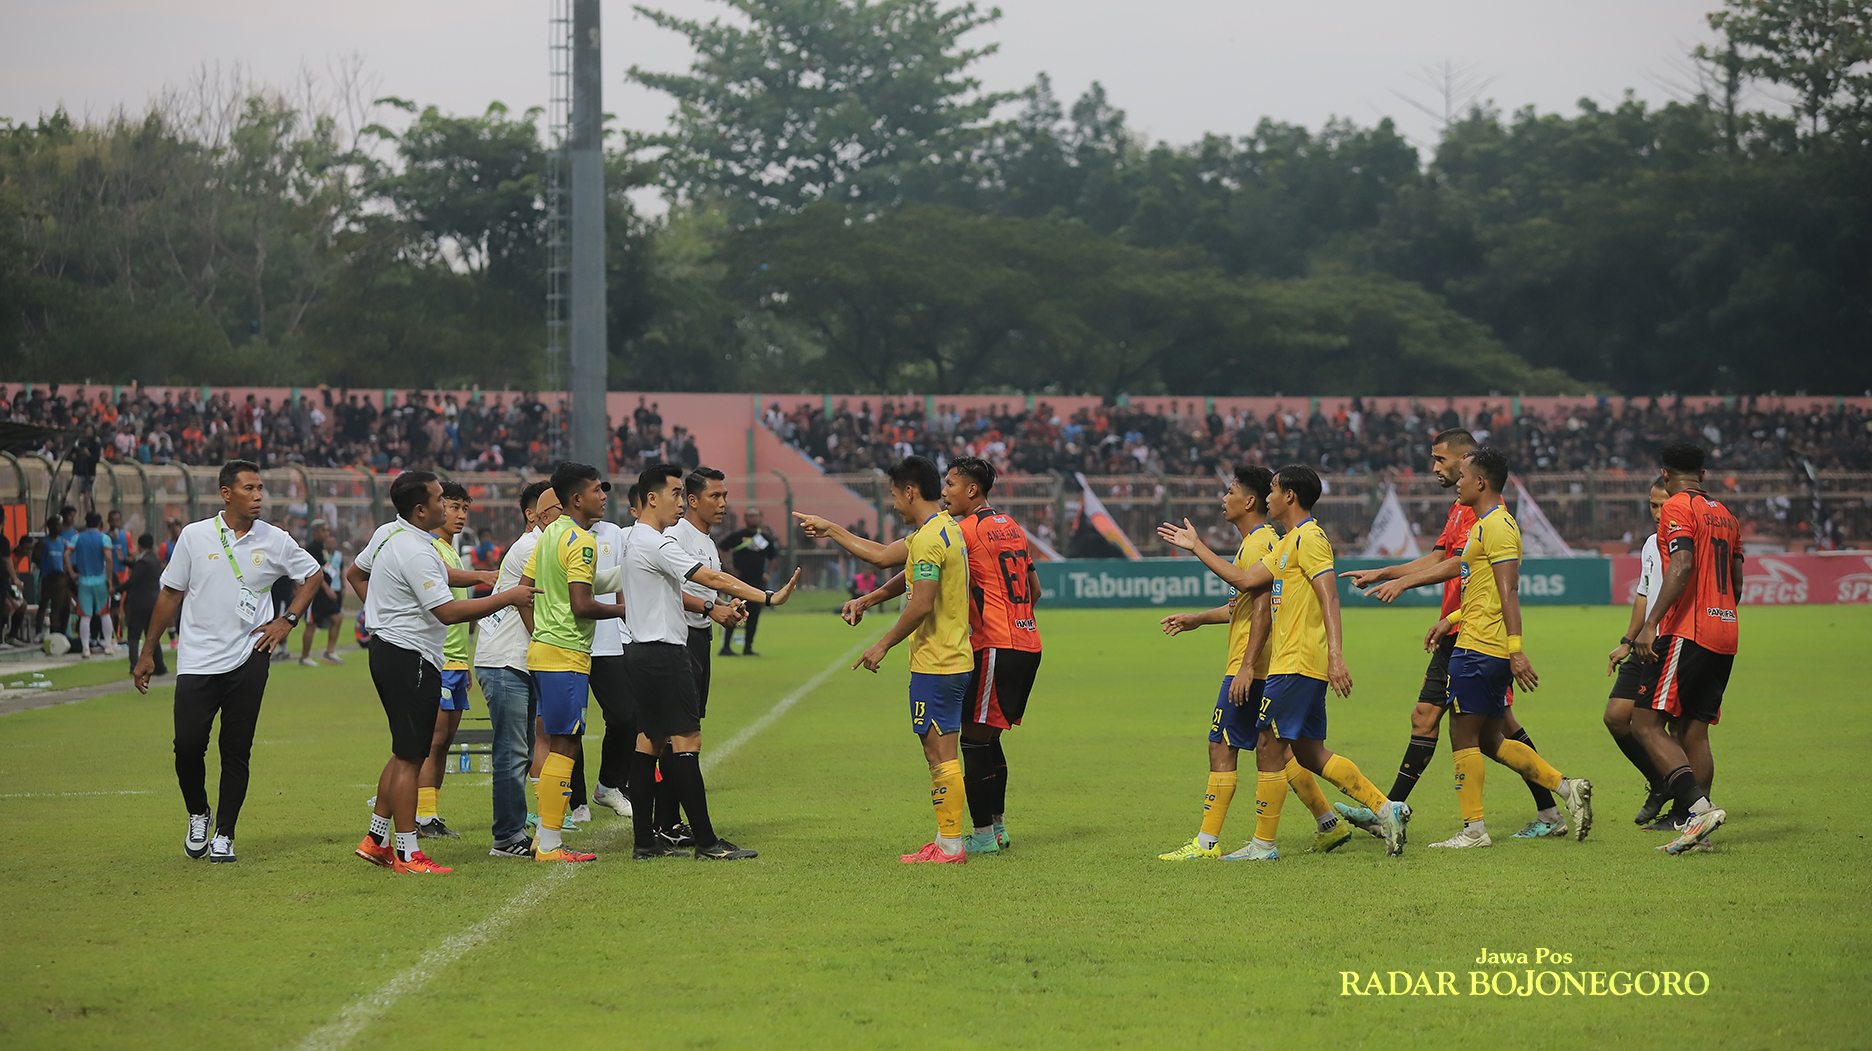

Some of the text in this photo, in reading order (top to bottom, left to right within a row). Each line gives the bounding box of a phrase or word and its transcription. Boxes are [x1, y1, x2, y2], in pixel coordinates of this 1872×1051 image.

[1710, 536, 1729, 596] 11
[1068, 571, 1200, 604] Tabungan
[914, 701, 926, 717] 13
